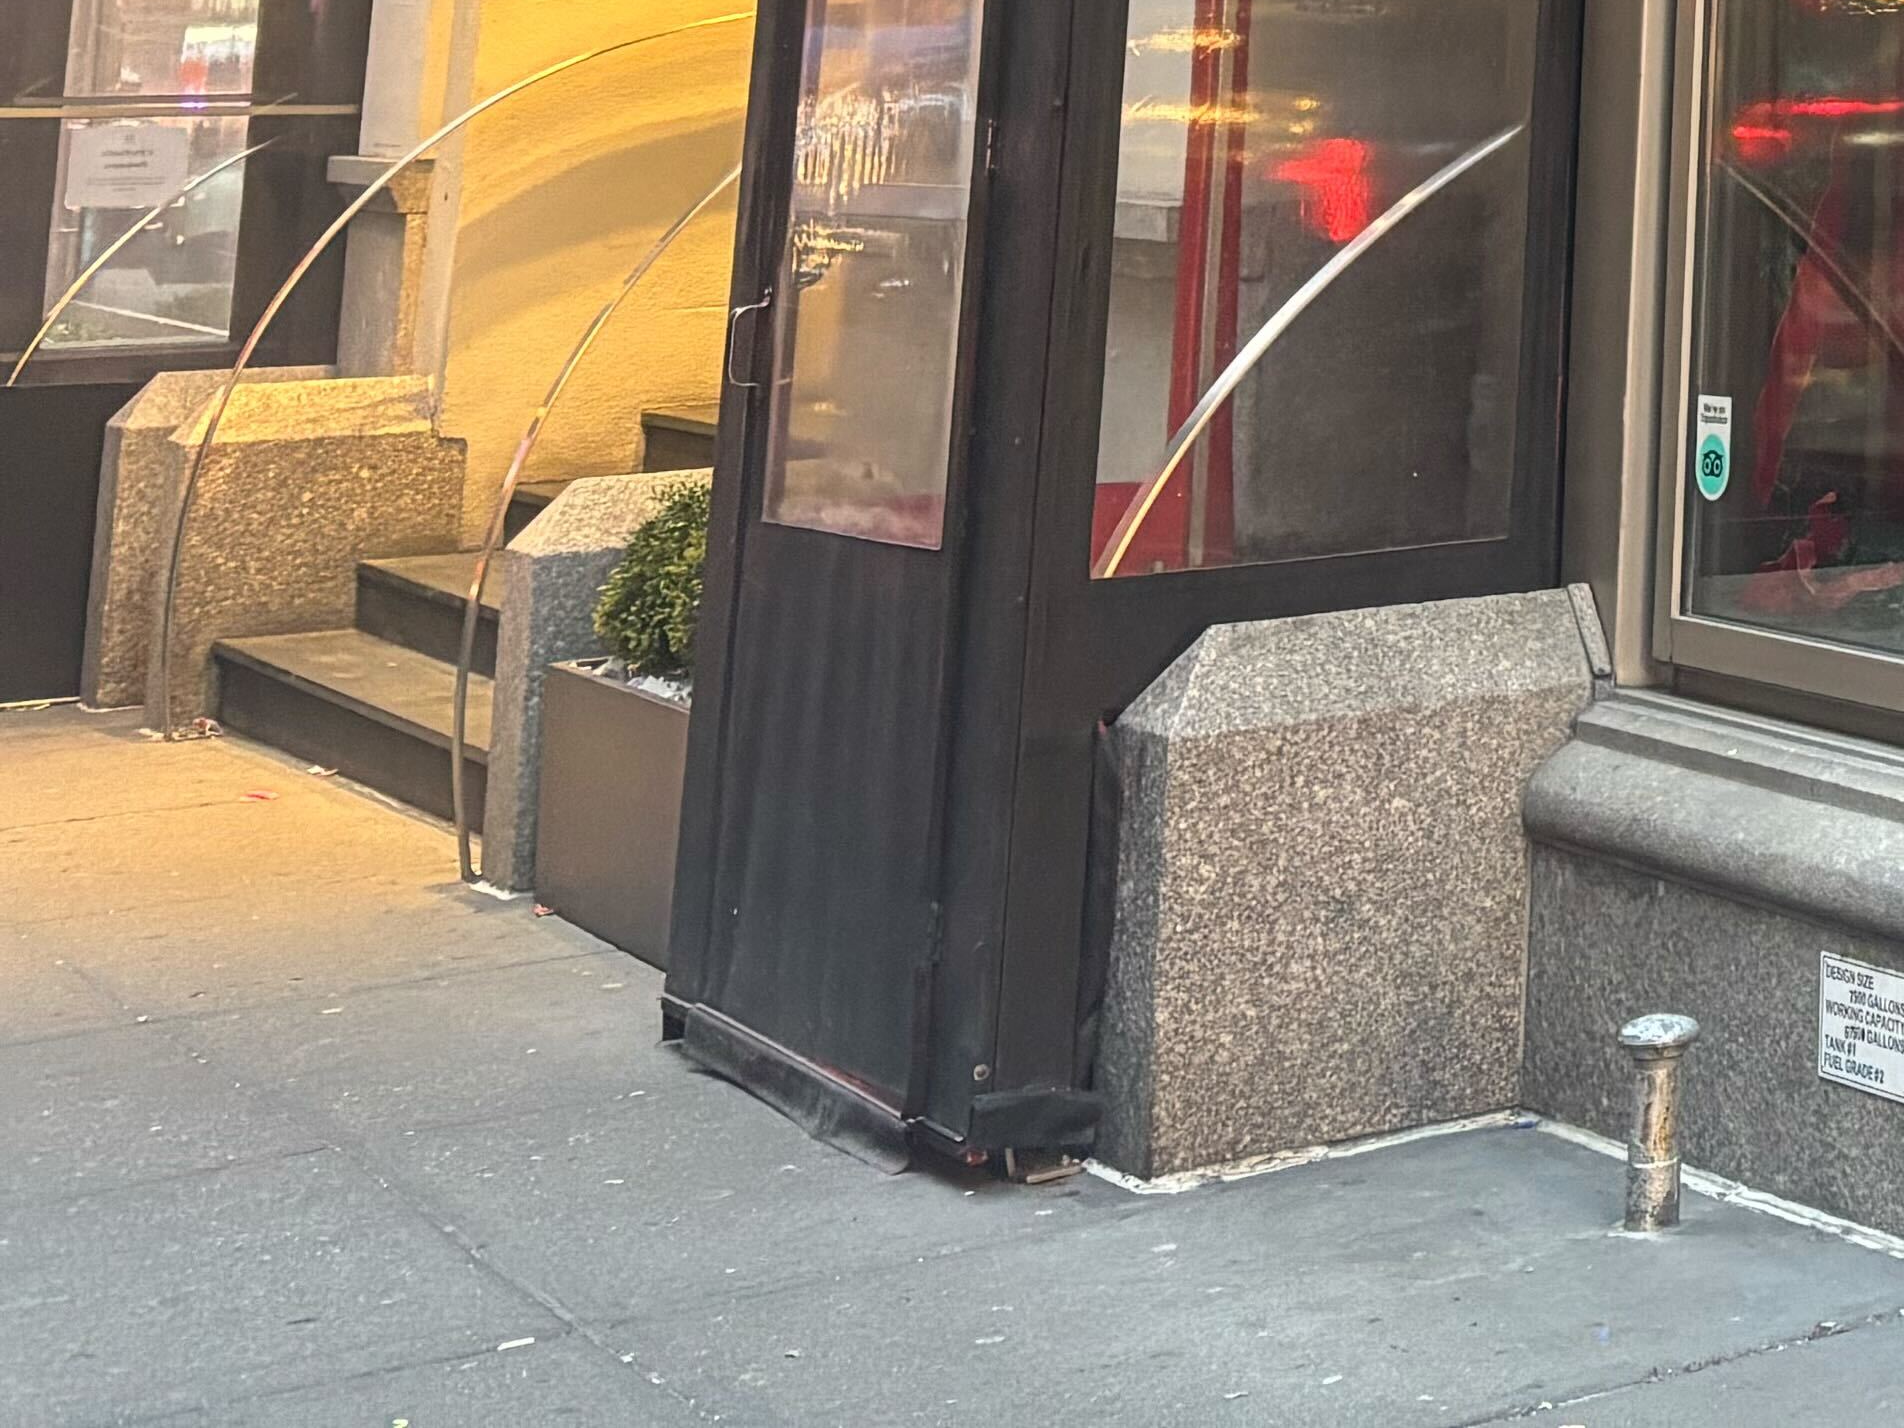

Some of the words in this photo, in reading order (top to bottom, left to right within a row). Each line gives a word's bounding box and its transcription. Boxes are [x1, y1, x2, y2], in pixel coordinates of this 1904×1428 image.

[1825, 961, 1855, 985] DESIGN
[1856, 972, 1875, 990] SIZE
[1825, 1000, 1864, 1024] WORKING
[1825, 1034, 1846, 1054] TANK
[1824, 1052, 1844, 1072] FUEL
[1844, 1059, 1873, 1081] GRADE
